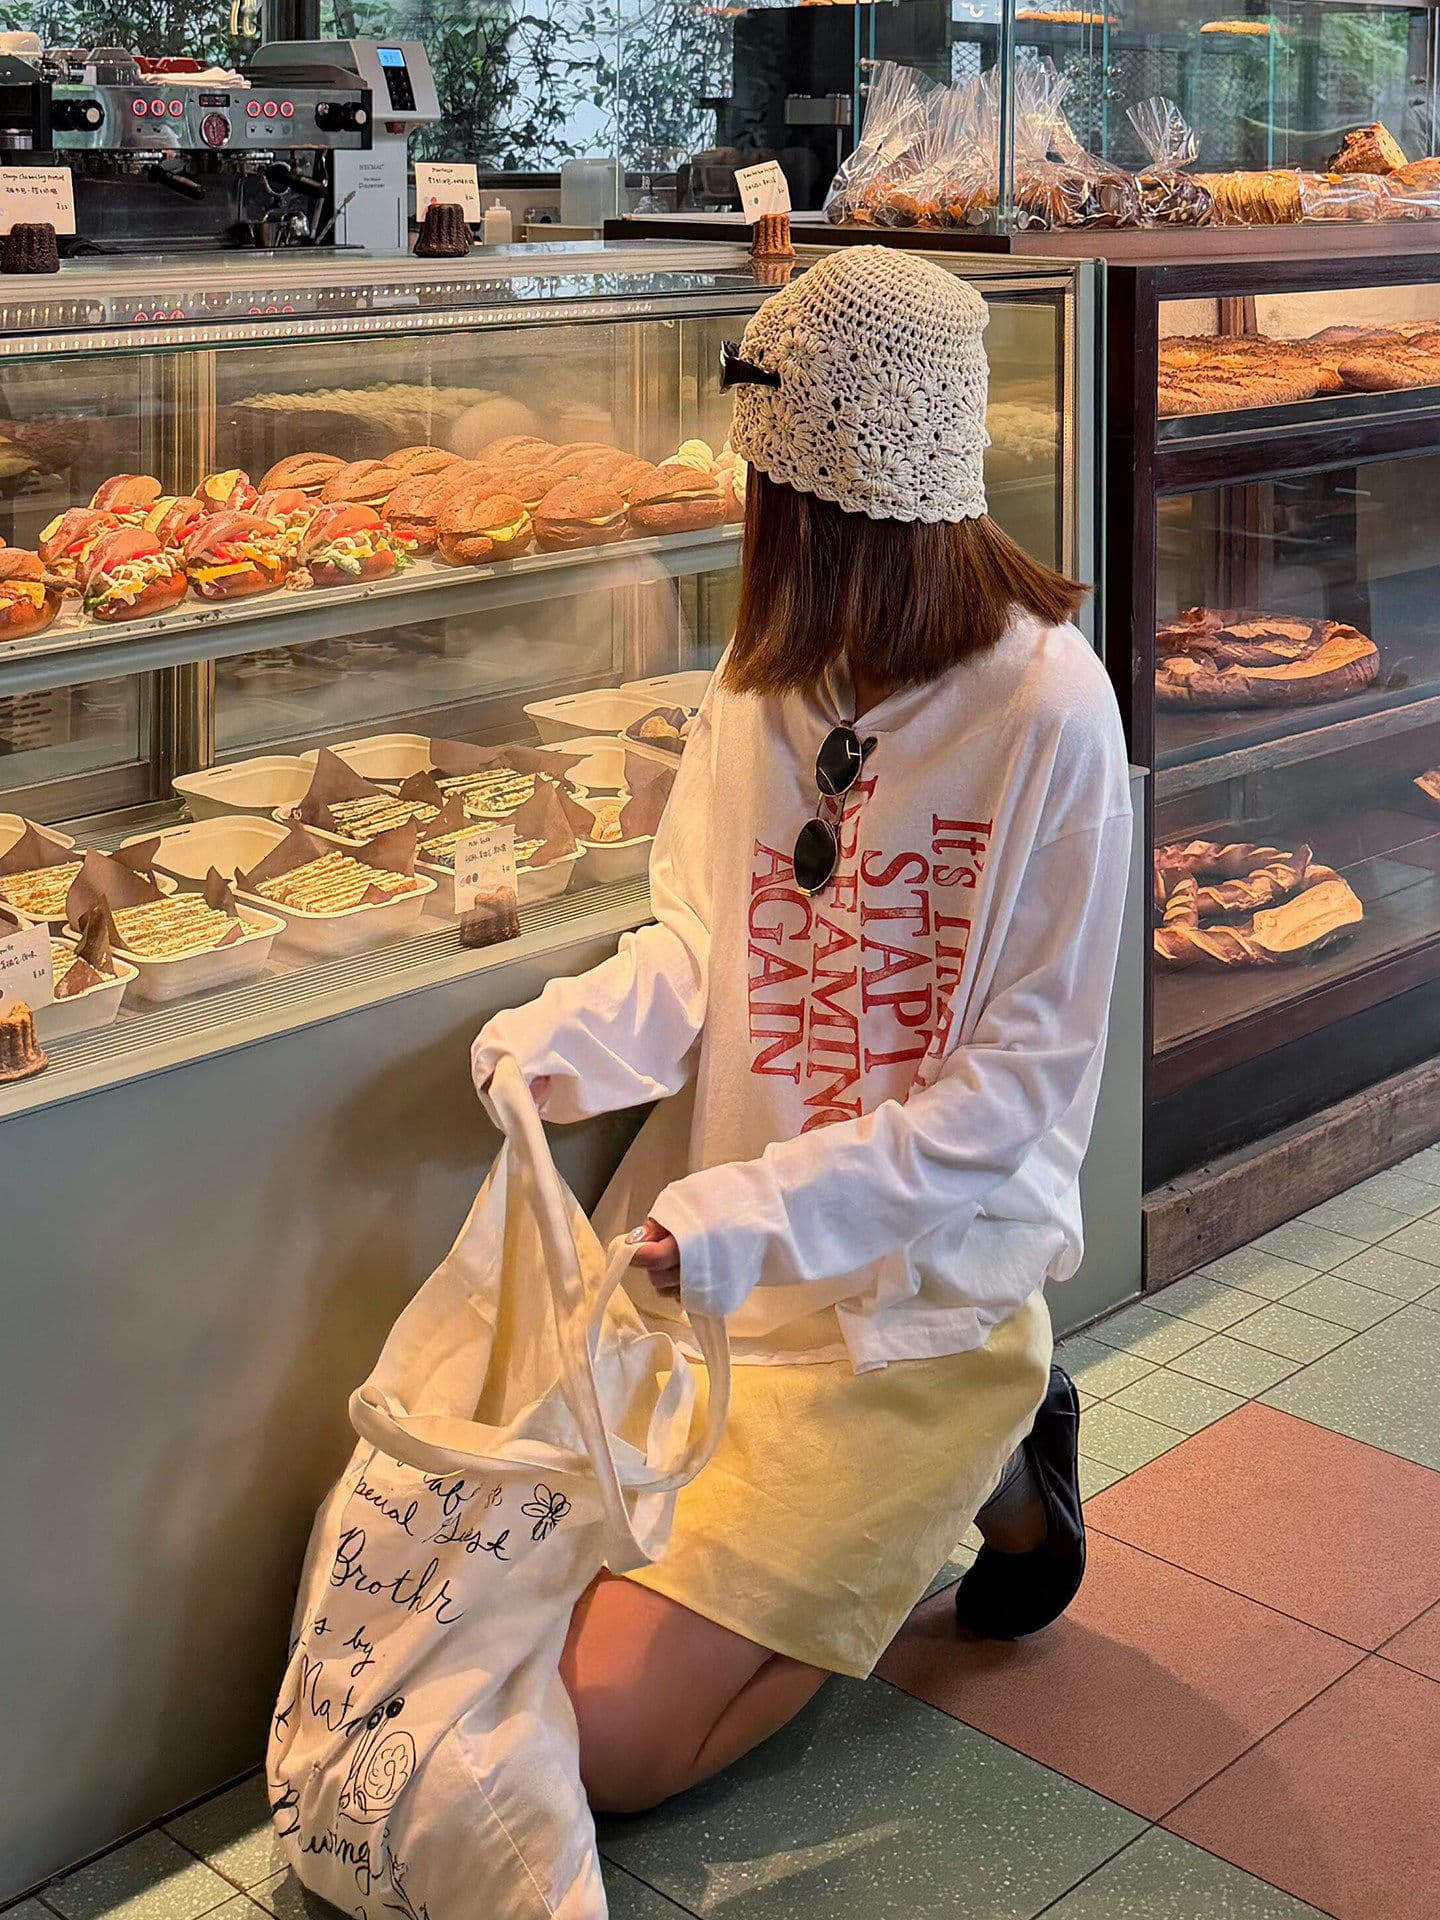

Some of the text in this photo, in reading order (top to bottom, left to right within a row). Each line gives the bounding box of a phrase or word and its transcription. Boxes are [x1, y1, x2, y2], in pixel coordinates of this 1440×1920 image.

[931, 813, 994, 889] It's
[747, 838, 814, 1085] AGAIN
[342, 1625, 376, 1678] by
